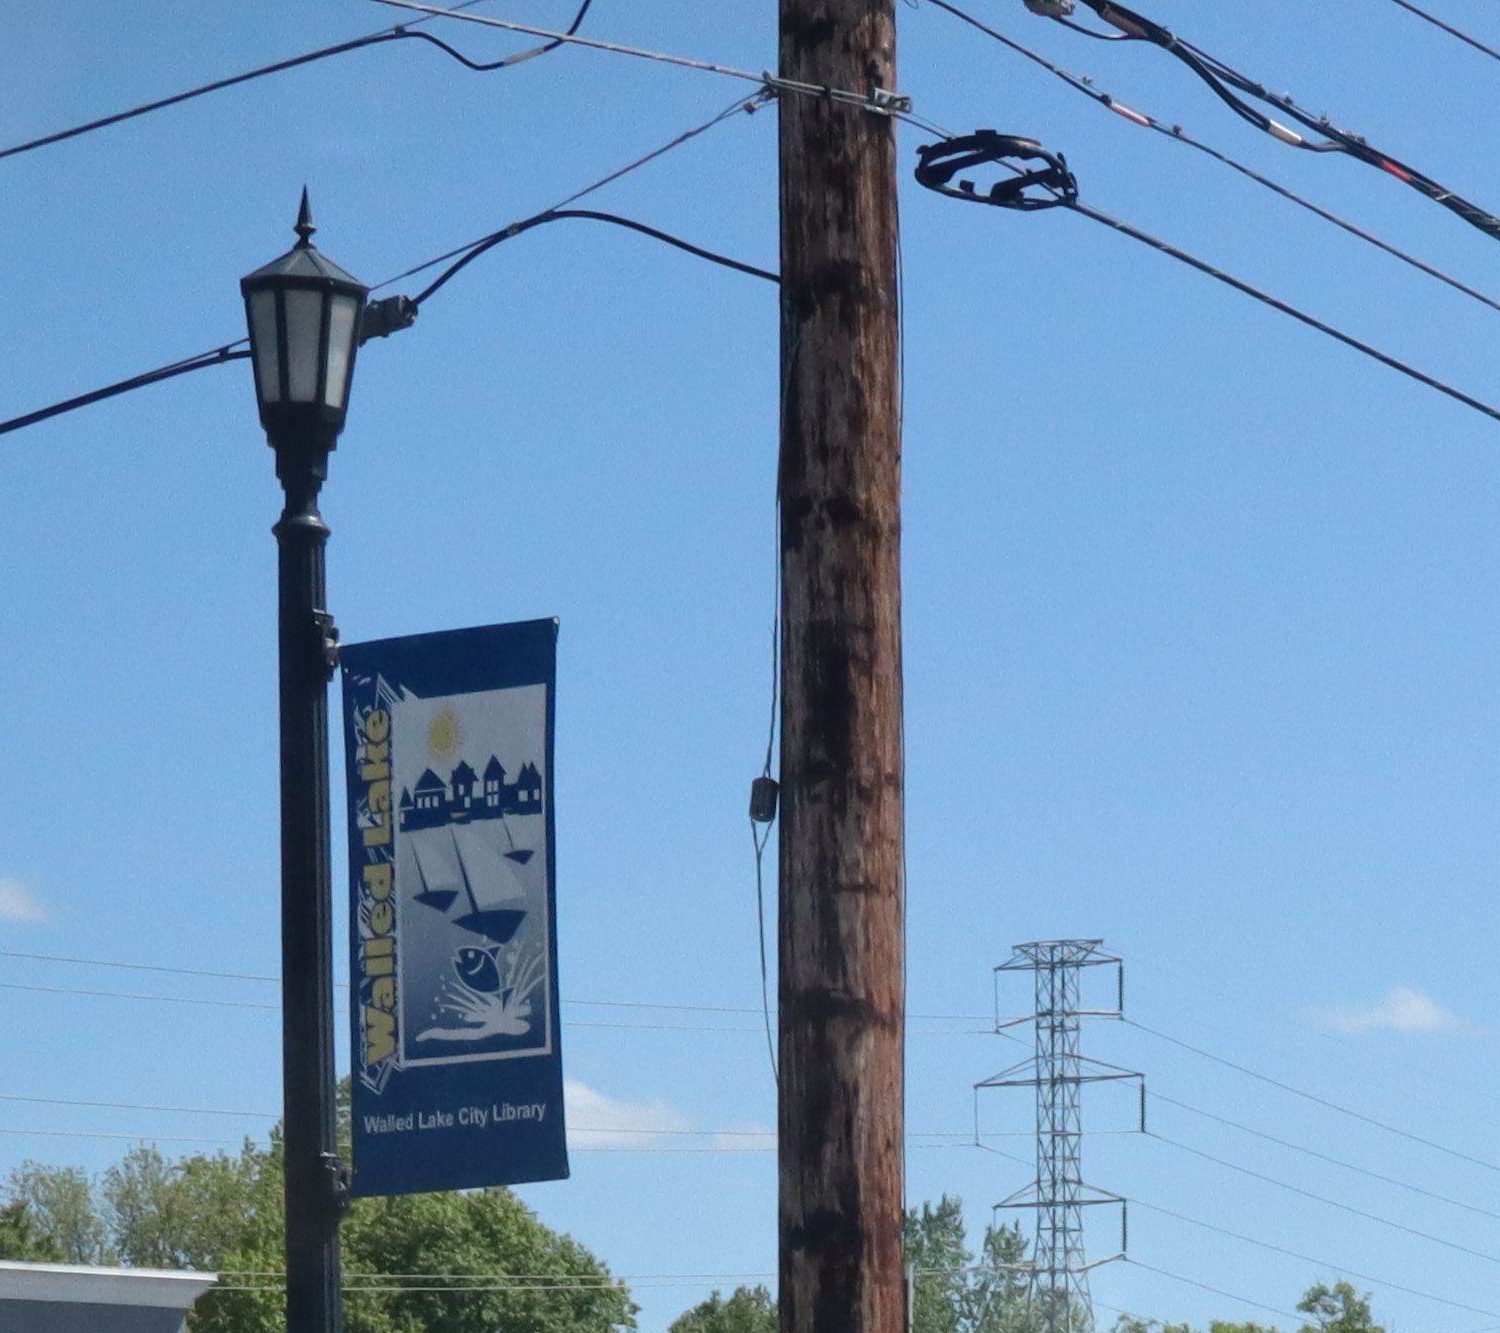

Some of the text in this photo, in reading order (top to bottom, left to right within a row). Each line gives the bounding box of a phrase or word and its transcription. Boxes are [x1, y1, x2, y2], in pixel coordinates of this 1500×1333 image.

[361, 709, 395, 1066] Walled Lake
[363, 1103, 546, 1134] Walled Lake City Library
